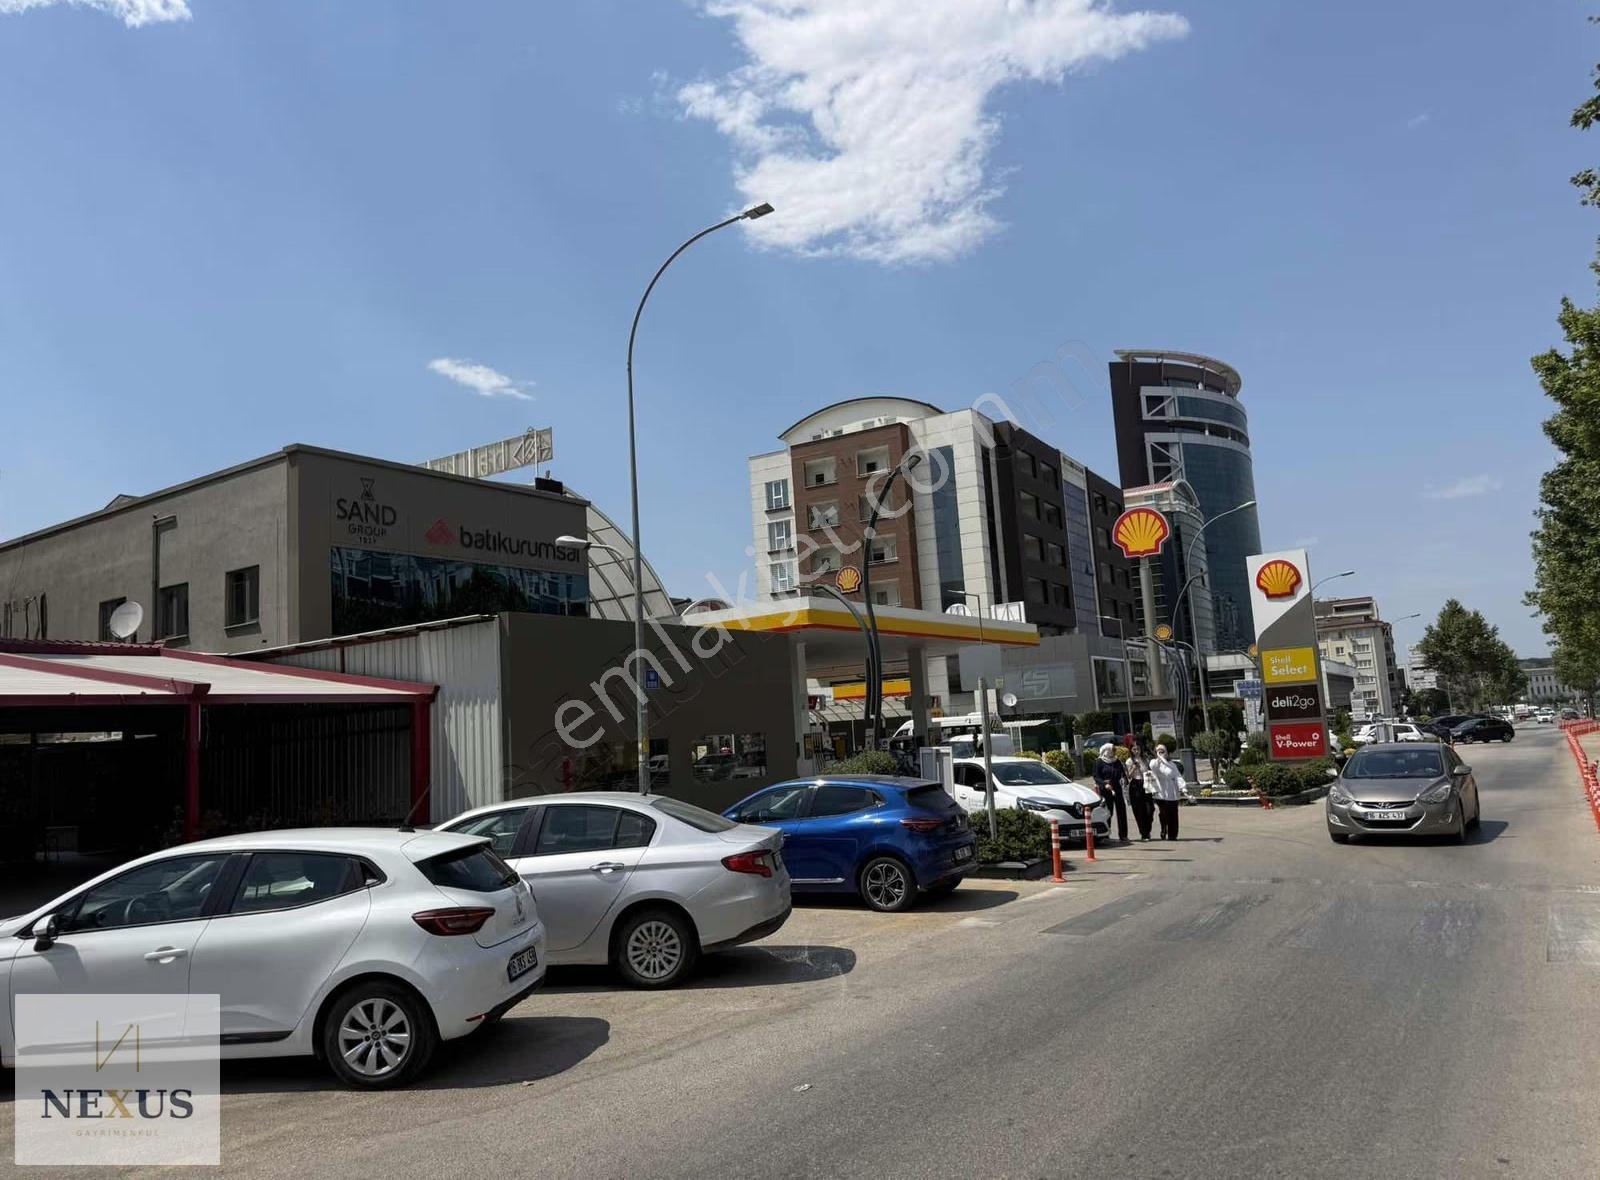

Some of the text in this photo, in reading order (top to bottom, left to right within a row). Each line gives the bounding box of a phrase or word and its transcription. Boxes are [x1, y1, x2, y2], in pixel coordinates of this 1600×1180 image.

[336, 497, 397, 526] SAND
[1270, 656, 1291, 664] Shell
[1271, 664, 1307, 676] Select
[1271, 695, 1315, 709] deli2go
[1276, 740, 1317, 748] V-Power
